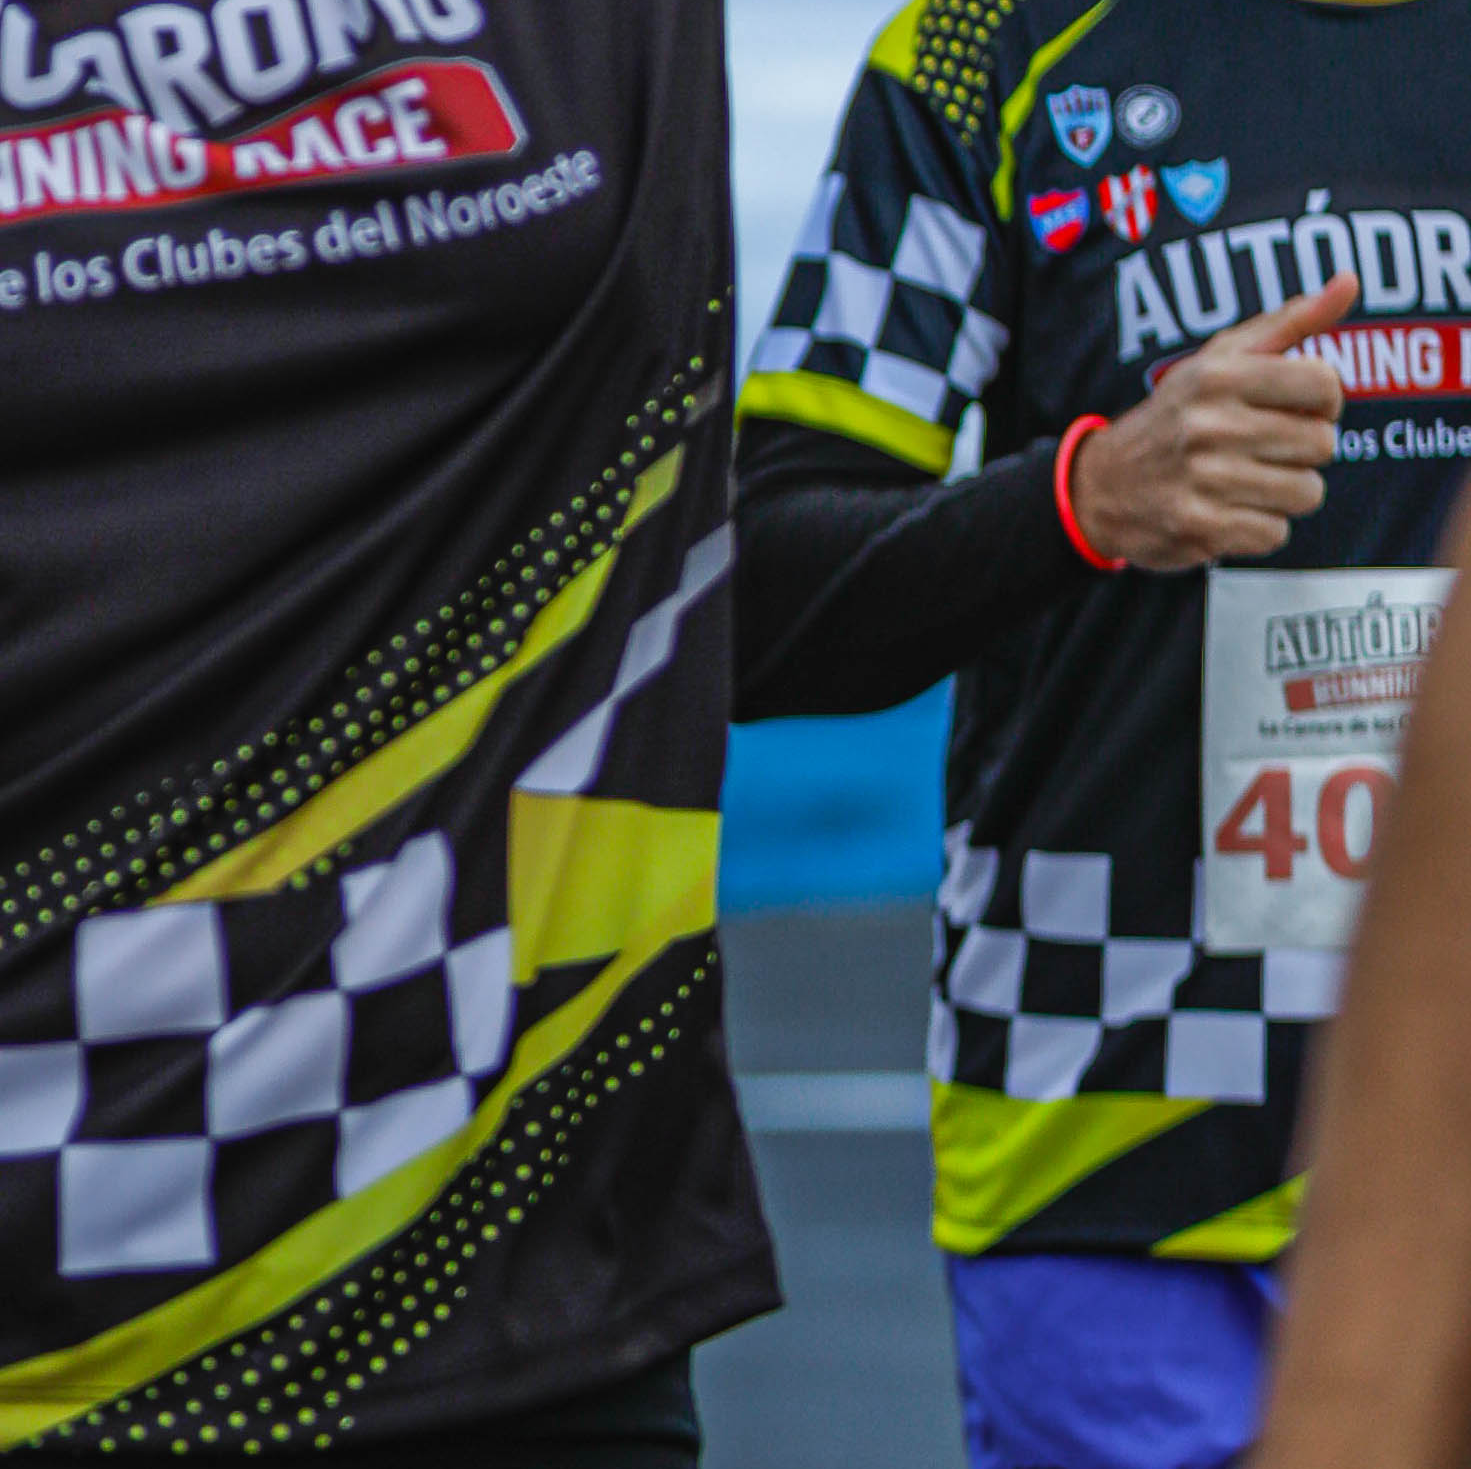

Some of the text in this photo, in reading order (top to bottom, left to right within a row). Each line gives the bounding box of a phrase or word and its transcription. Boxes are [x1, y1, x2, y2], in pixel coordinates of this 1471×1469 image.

[232, 78, 448, 179] RACE
[36, 251, 115, 304] los
[122, 226, 306, 289] Clubes
[312, 199, 403, 264] del
[403, 148, 602, 245] Noroeste
[1215, 766, 1400, 881] 40
